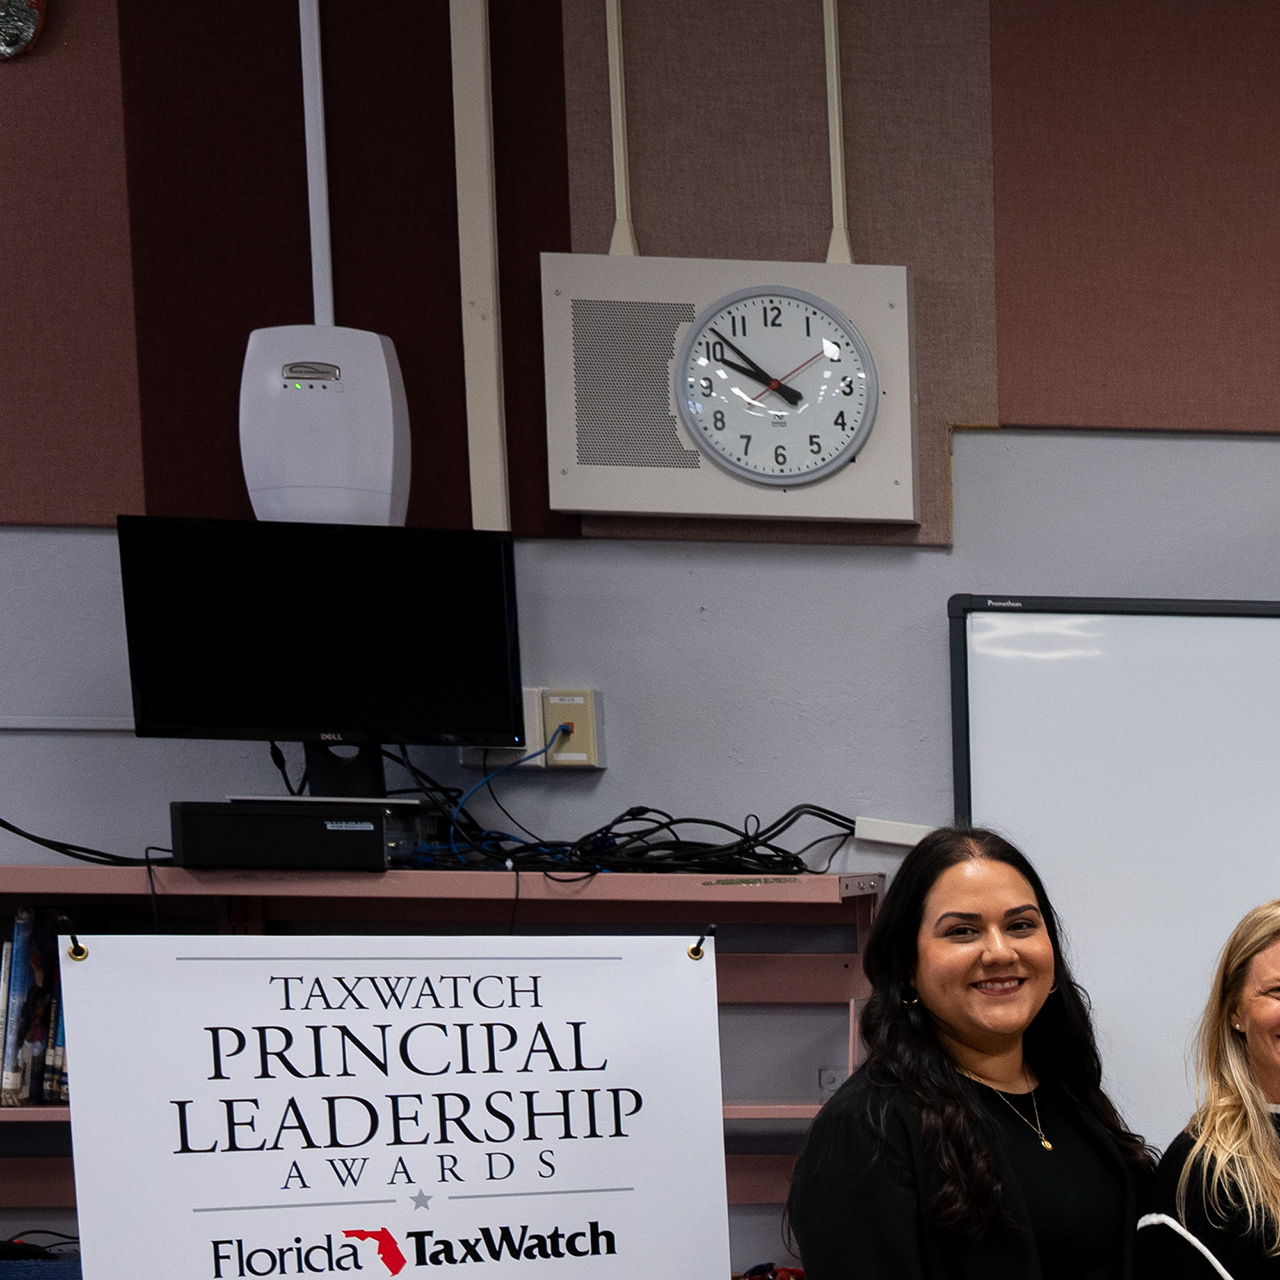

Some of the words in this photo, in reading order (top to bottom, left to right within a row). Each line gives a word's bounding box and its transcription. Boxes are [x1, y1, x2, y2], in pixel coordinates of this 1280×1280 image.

[731, 315, 747, 337] 11
[762, 306, 782, 328] 12
[805, 316, 811, 337] 1
[705, 341, 725, 362] 10
[700, 376, 714, 397] 9
[841, 375, 854, 396] 3
[713, 411, 726, 431] 8
[834, 411, 847, 431] 4
[739, 435, 752, 456] 7
[809, 435, 822, 454] 5
[774, 445, 787, 466] 6
[987, 599, 1023, 607] Promethean
[320, 733, 343, 741] DELL
[269, 975, 542, 1010] TAXWATCH
[204, 1022, 607, 1080] PRINCIPAL
[170, 1088, 642, 1154] LEADERSHIP
[281, 1150, 555, 1189] AWARDS
[211, 1234, 363, 1278] Florida
[406, 1221, 617, 1266] TaxWatch
